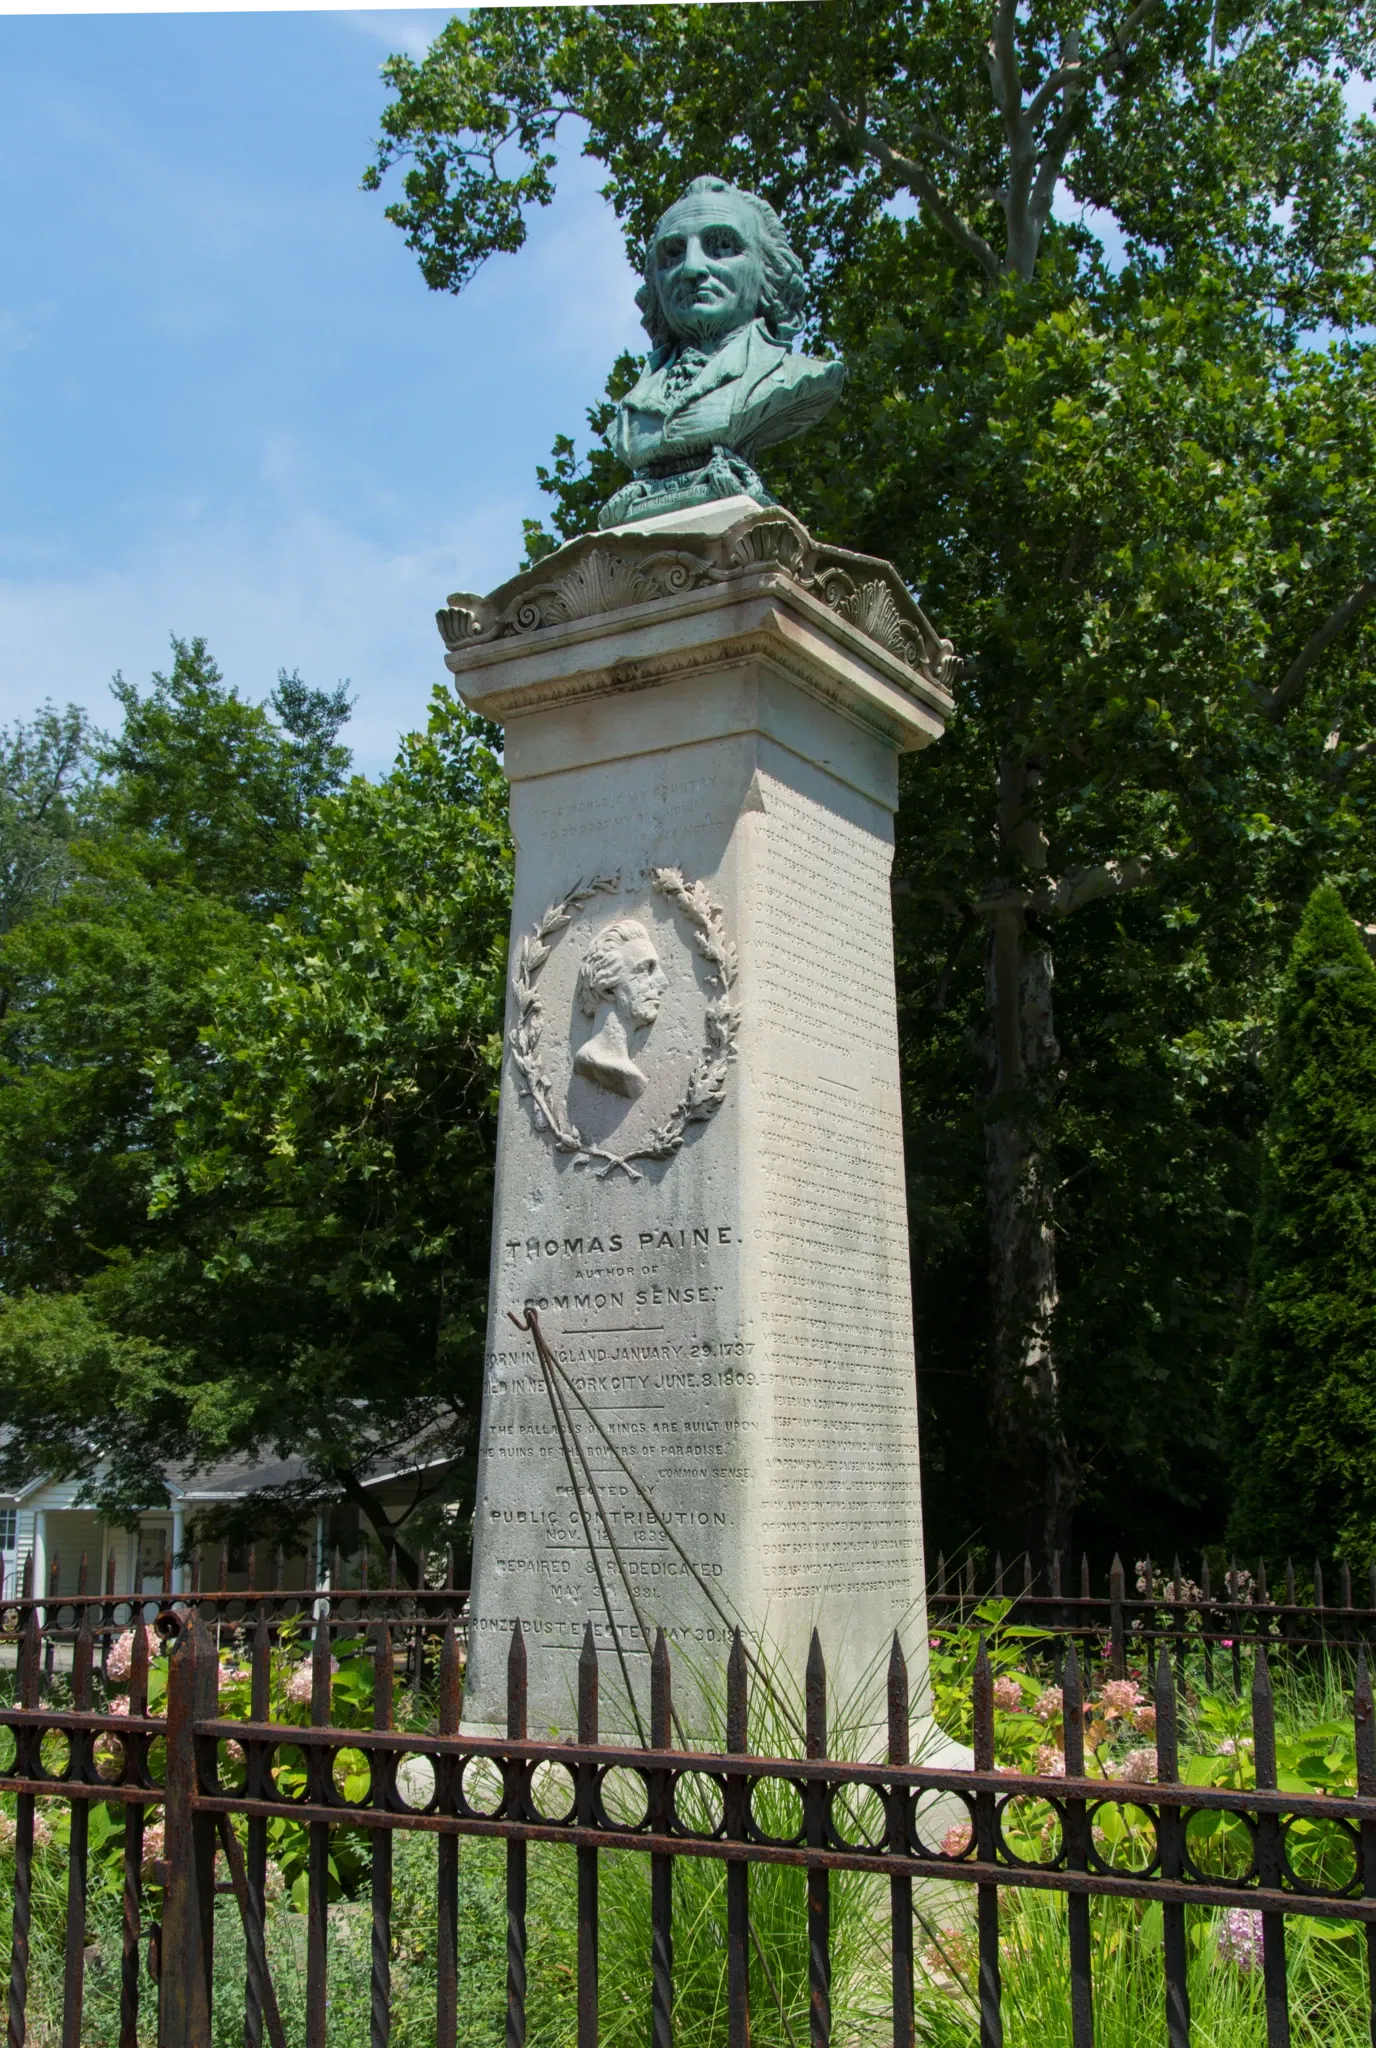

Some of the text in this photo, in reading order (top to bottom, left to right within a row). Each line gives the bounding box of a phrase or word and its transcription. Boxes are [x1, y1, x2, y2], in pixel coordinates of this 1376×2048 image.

[505, 1226, 743, 1260] THOMAS PAINE.
[574, 1265, 659, 1279] AUTHOR OF
[611, 1345, 683, 1362] JANUARY
[611, 1375, 649, 1390] CITY
[489, 1426, 514, 1436] THE
[608, 1423, 646, 1434] KINGS
[652, 1422, 678, 1433] ARE
[684, 1421, 719, 1433] BUILT
[725, 1420, 759, 1432] UPON
[500, 1447, 534, 1458] RUINS
[540, 1446, 553, 1458] OF
[642, 1446, 656, 1457] OF
[659, 1468, 707, 1479] COMMON
[491, 1510, 557, 1524] PUBLIC
[497, 1559, 571, 1574] REPAIRED
[551, 1584, 581, 1597] MAY
[469, 1618, 515, 1632] RONZE
[523, 1620, 565, 1634] BUST
[571, 1622, 650, 1639] EECTED
[657, 1626, 690, 1640] AY
